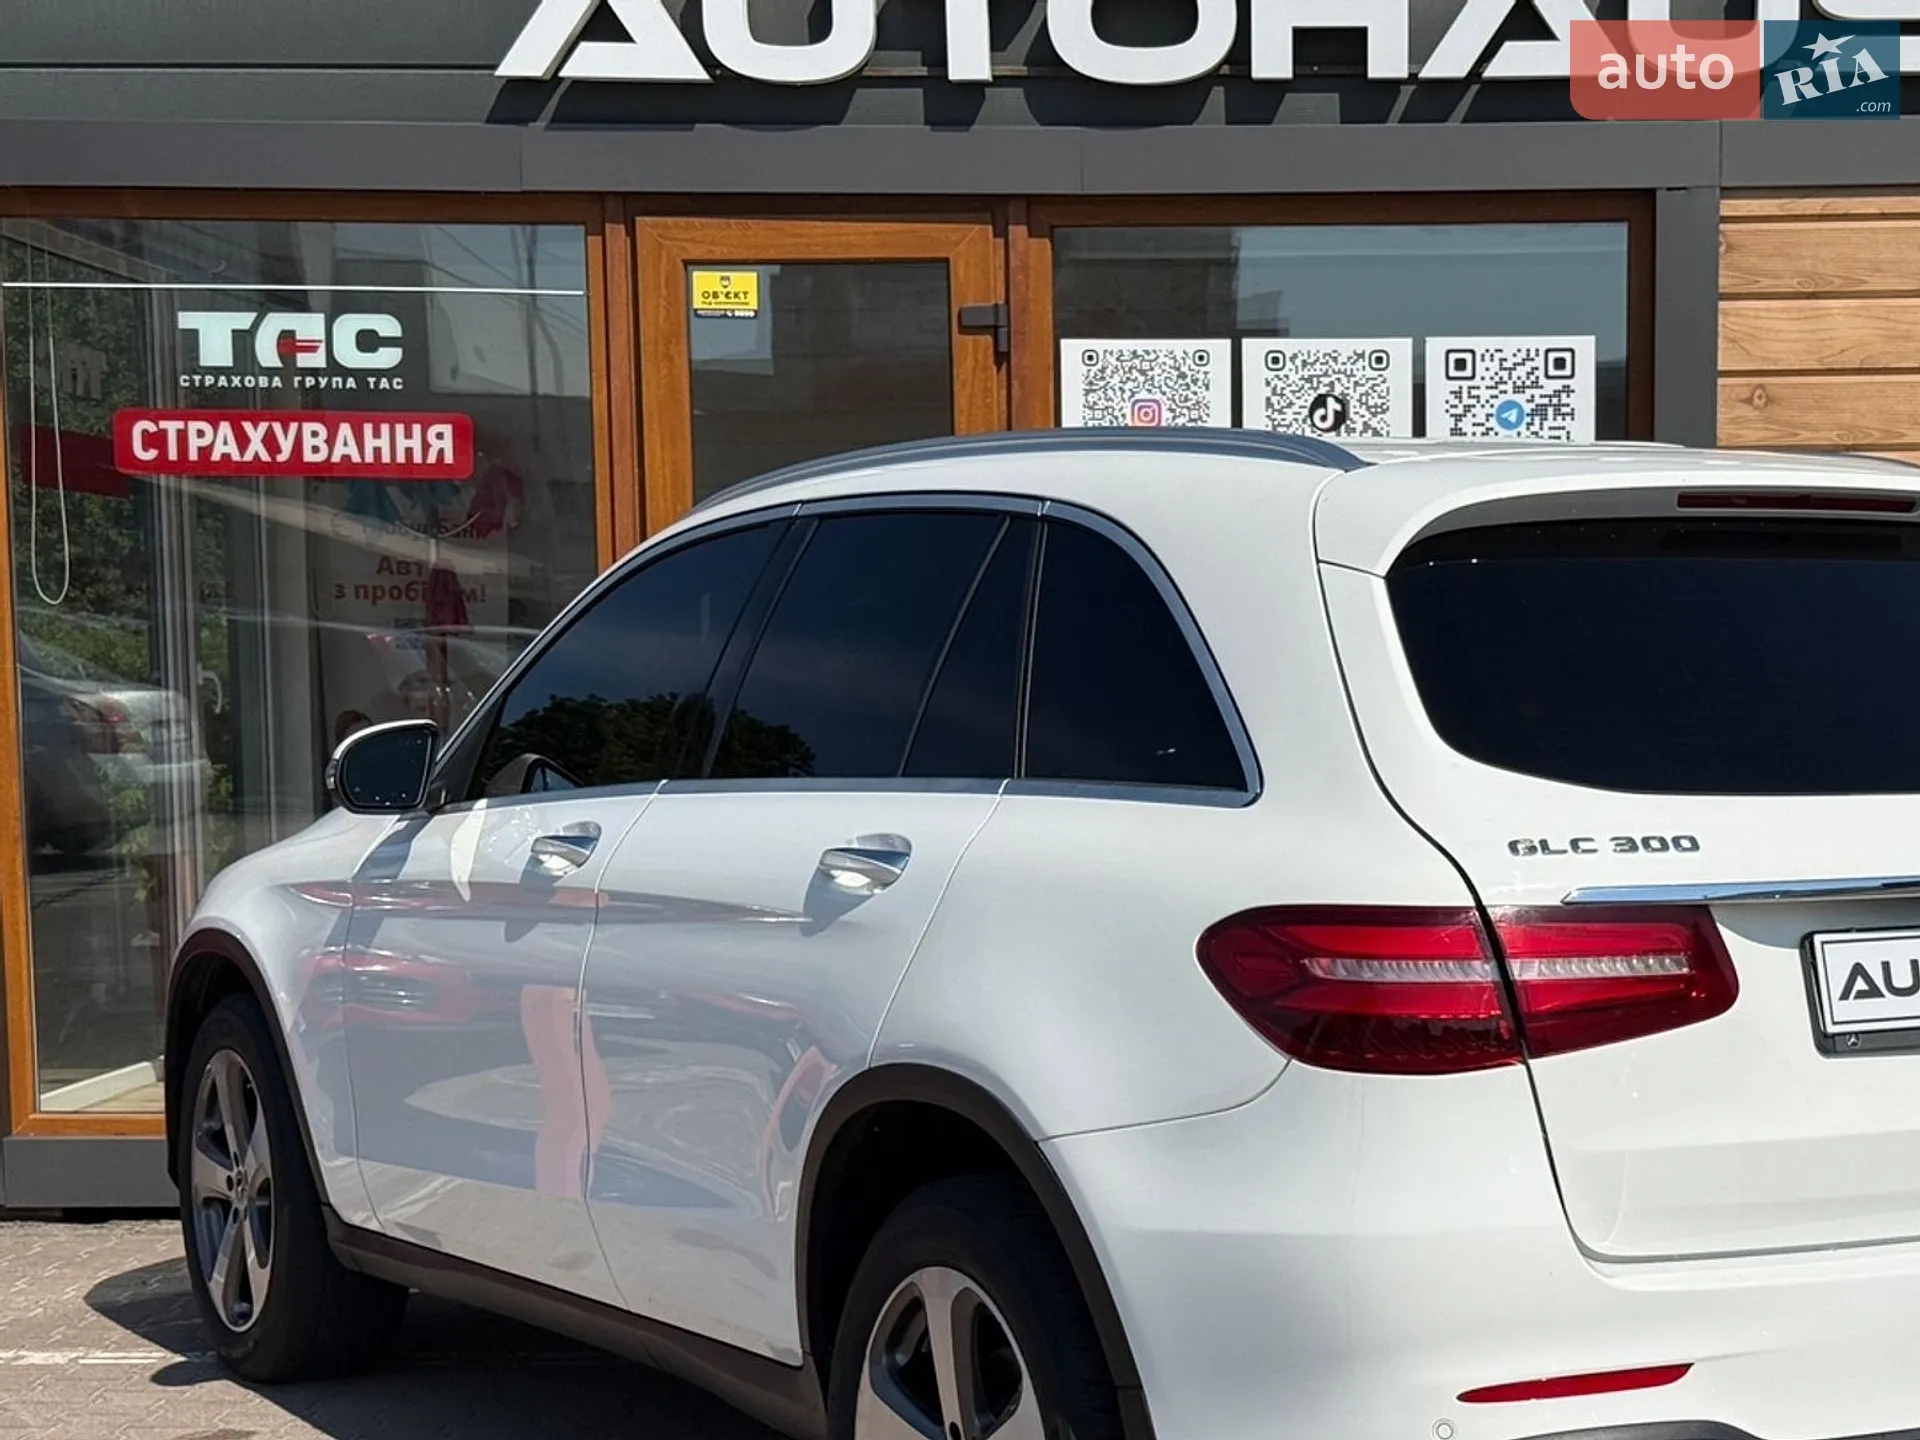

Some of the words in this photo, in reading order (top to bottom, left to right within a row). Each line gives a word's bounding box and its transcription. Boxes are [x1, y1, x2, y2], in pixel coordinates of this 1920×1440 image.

[179, 375, 284, 389] СТРАХОВА
[293, 376, 358, 390] ГРУПА
[366, 377, 405, 390] ТАС
[131, 419, 455, 465] СТРАХУВАННЯ
[1507, 836, 1600, 857] GLC
[1609, 834, 1701, 855] 300
